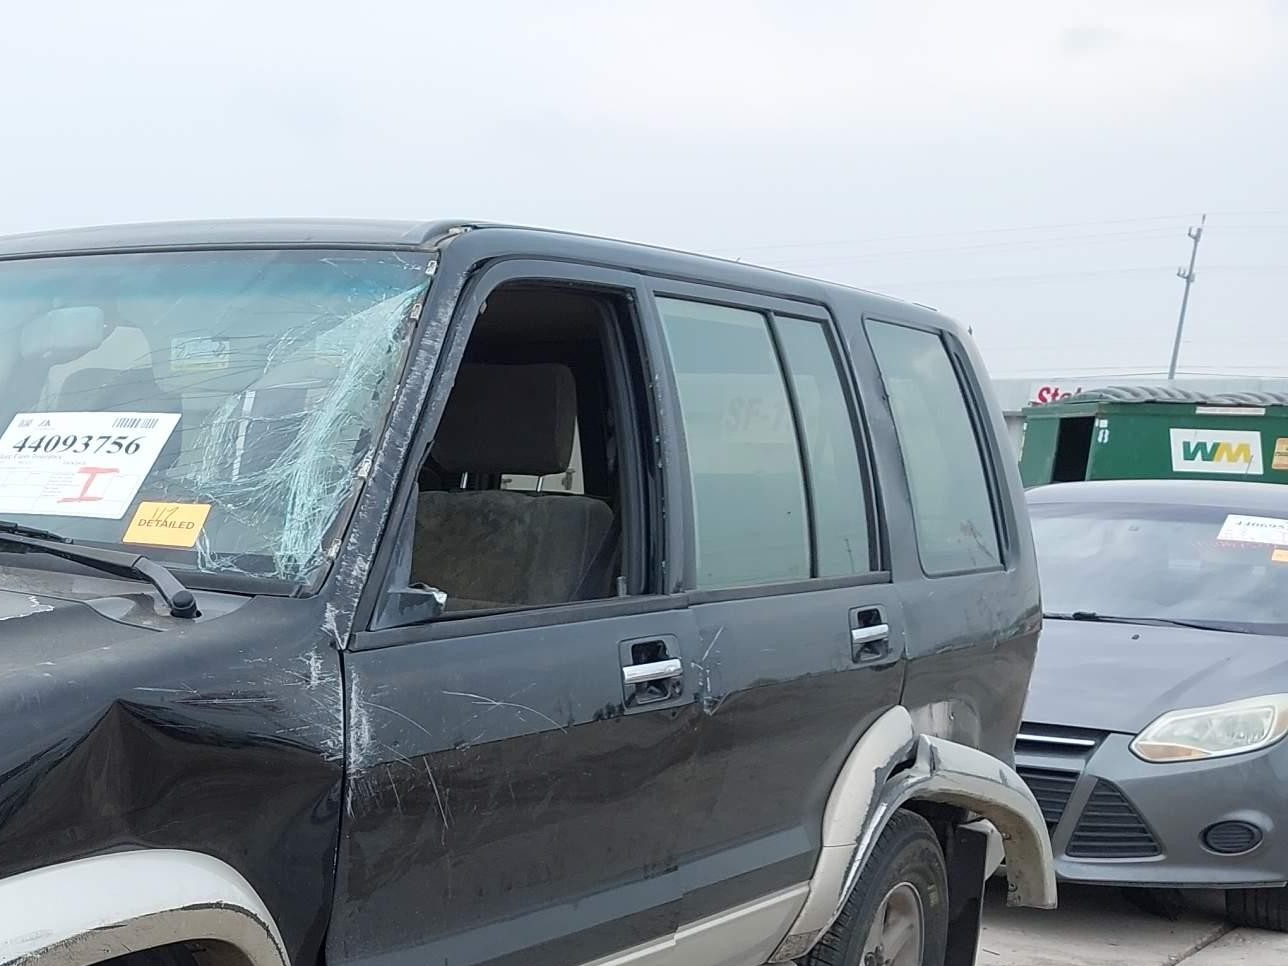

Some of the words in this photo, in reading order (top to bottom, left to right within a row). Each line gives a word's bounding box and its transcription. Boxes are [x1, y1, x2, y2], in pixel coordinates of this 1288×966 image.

[12, 435, 146, 455] 44093756
[1182, 441, 1251, 463] WM
[137, 518, 195, 530] DETAILED
